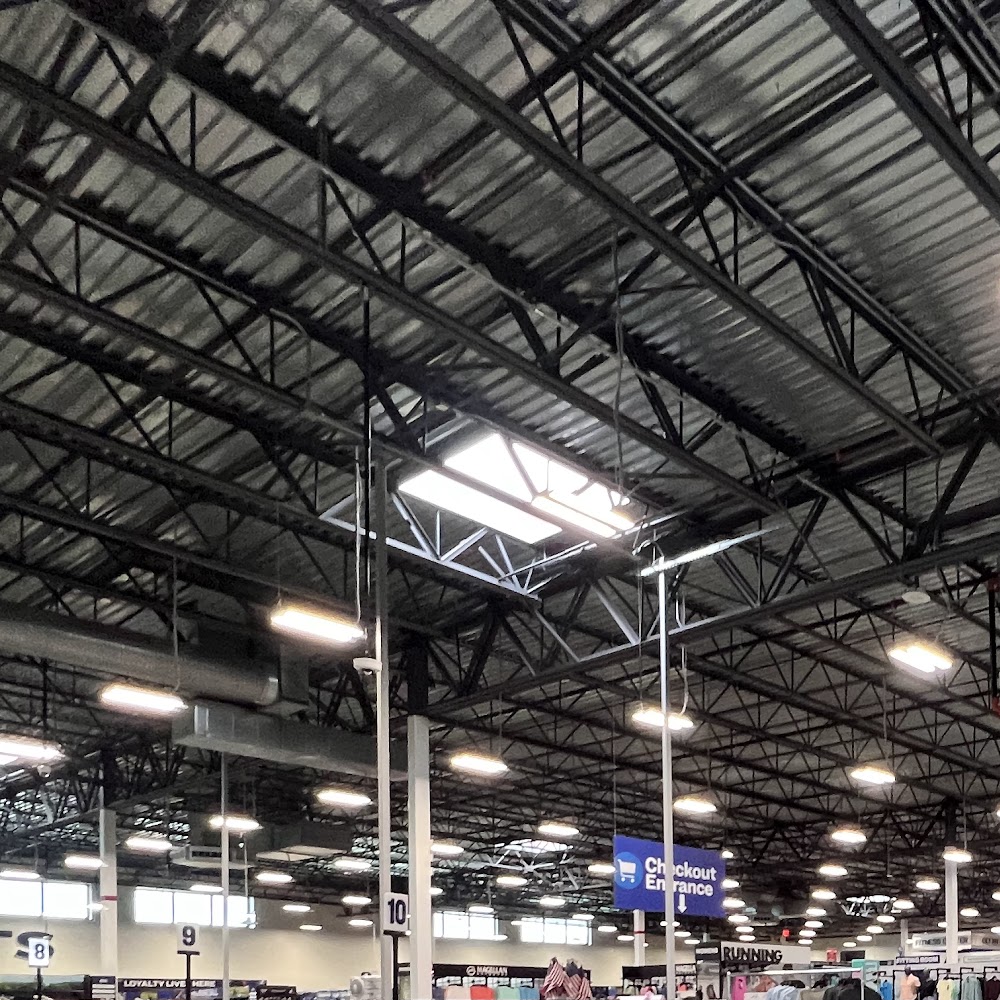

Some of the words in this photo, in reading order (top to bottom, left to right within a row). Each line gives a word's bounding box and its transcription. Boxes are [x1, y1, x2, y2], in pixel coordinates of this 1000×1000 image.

[645, 857, 717, 881] Chckout
[645, 874, 714, 897] Enrance
[387, 898, 407, 925] 10
[182, 925, 195, 946] 9
[35, 943, 45, 959] 8
[723, 946, 783, 964] RUNNING
[123, 979, 164, 988] LOYALTY
[166, 980, 187, 988] LIVE
